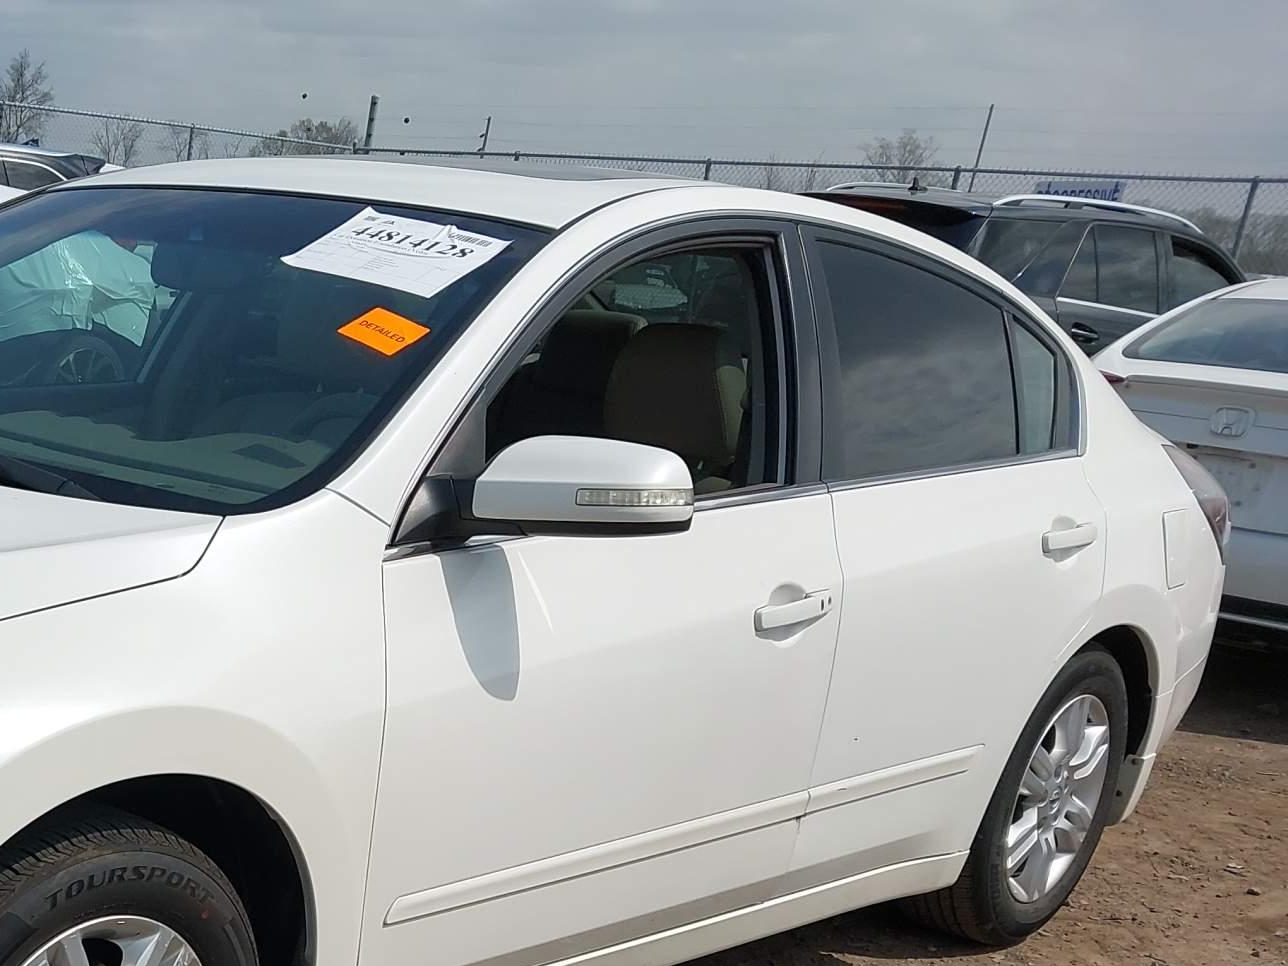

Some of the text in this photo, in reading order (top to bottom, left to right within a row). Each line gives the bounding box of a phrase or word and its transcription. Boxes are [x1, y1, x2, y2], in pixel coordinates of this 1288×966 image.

[352, 226, 474, 258] 44814128
[359, 319, 406, 343] DETAILED
[46, 866, 214, 911] TOURSPORT
